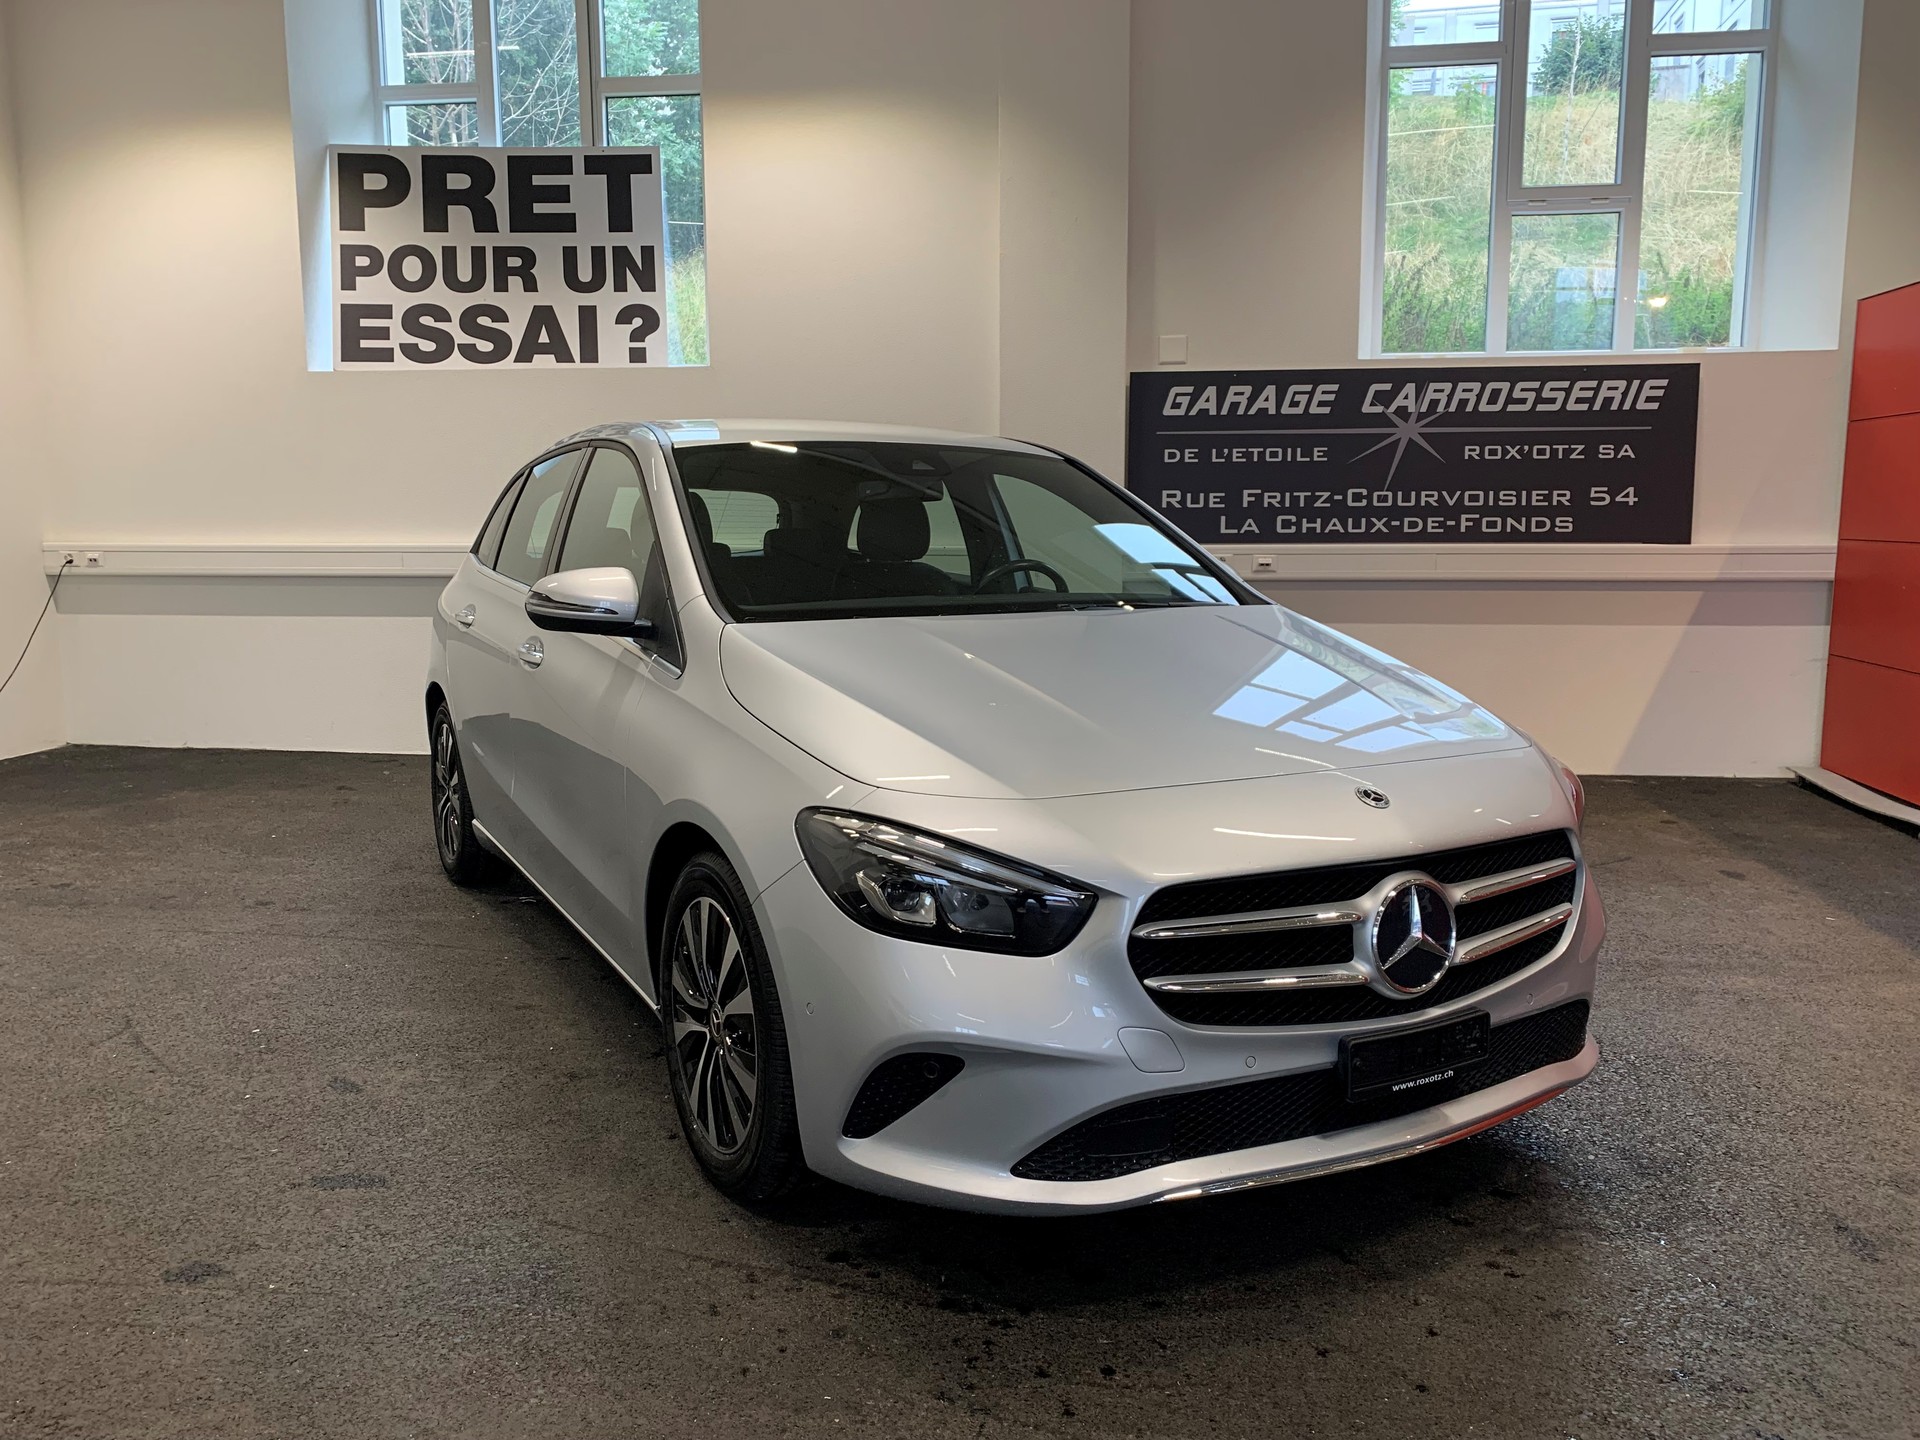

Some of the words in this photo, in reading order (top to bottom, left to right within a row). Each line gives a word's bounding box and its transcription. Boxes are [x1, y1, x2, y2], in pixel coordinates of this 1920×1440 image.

[337, 153, 653, 233] PRET
[340, 244, 539, 293] POUR
[562, 245, 657, 293] UN
[1162, 384, 1340, 416] GARAGE
[1361, 379, 1669, 414] CARROSSERIE
[1164, 449, 1199, 463] DE
[1212, 447, 1328, 462] L'ETOILE
[1464, 444, 1586, 460] ROX'OTZ
[1598, 444, 1636, 459] SA
[1590, 486, 1639, 506] 54
[1392, 1069, 1454, 1091] www.roxotz.ch
